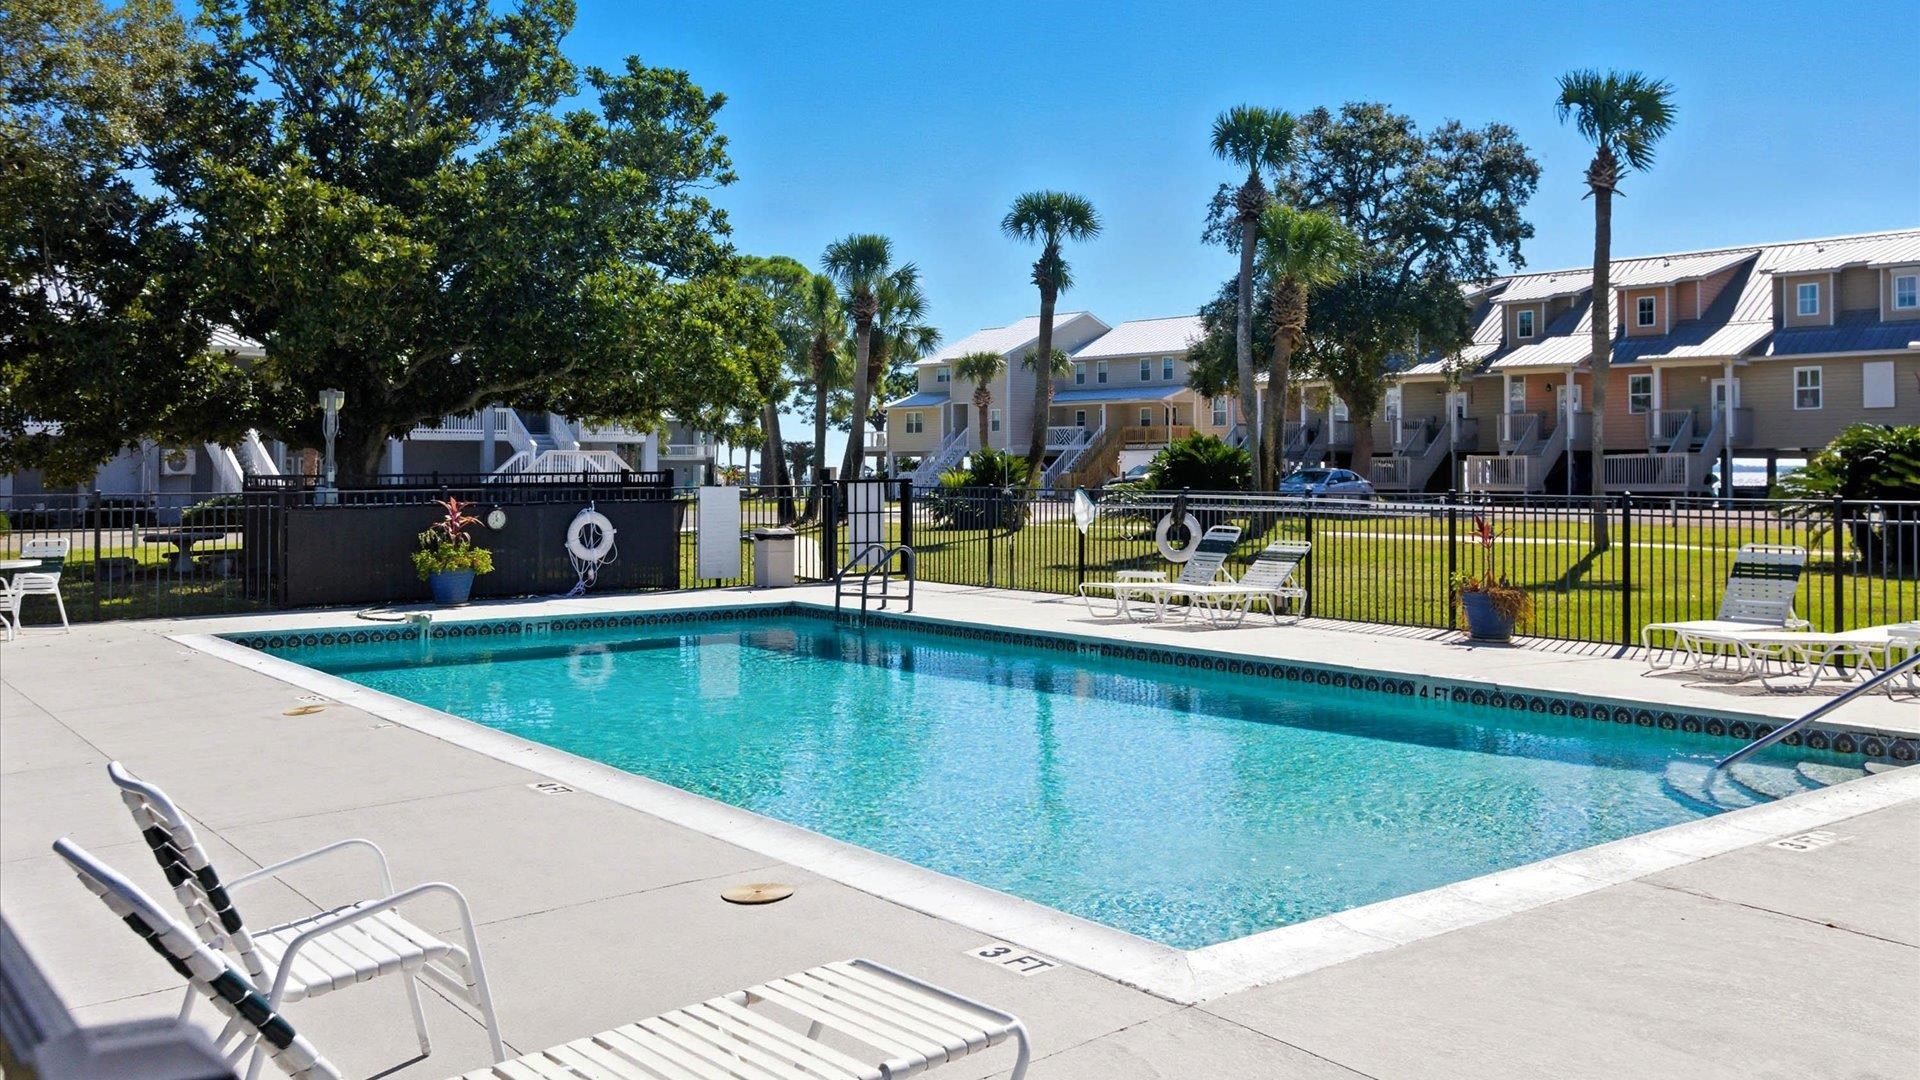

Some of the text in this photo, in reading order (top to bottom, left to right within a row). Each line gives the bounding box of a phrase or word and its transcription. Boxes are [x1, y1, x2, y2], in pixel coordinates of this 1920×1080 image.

[537, 622, 550, 631] FT
[1420, 685, 1450, 701] 4 FT
[979, 947, 1054, 972] 3 FT
